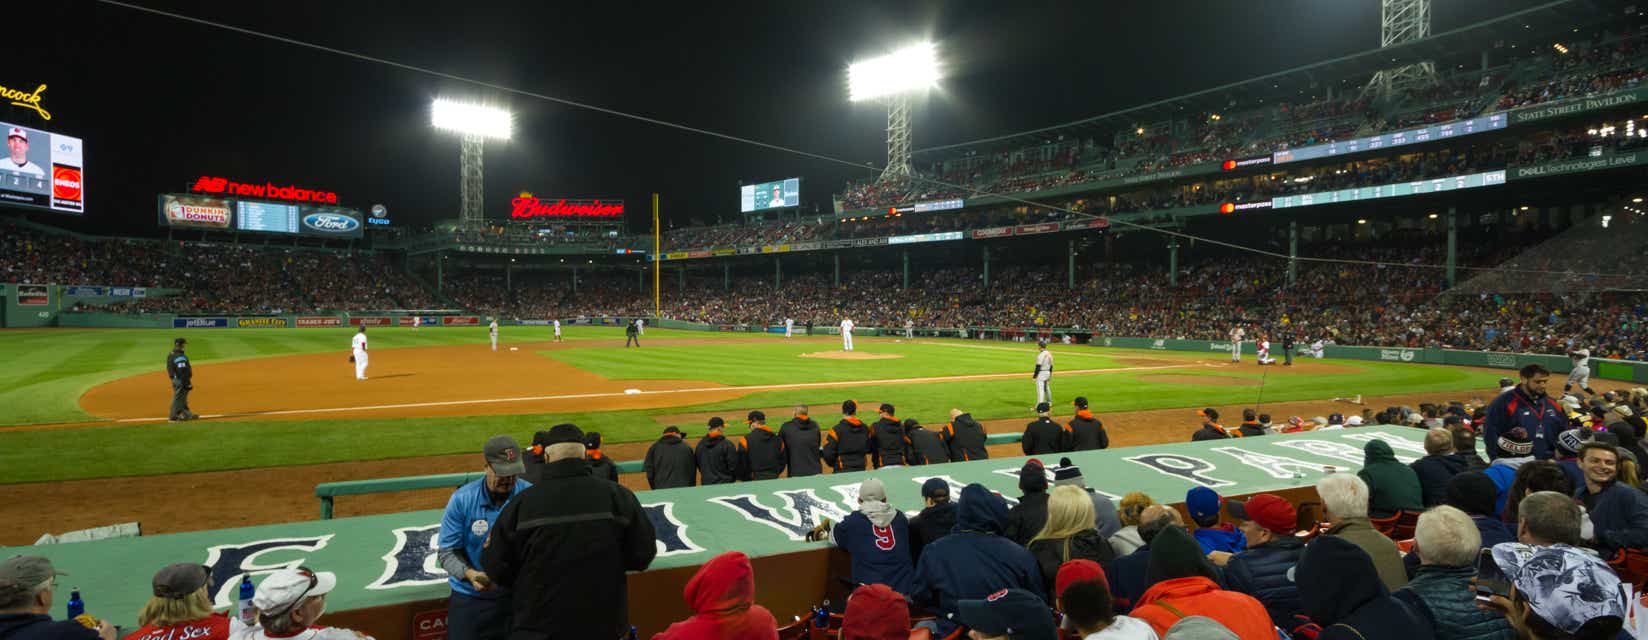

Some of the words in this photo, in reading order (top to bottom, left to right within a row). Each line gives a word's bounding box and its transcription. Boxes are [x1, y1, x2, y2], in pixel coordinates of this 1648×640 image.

[0, 84, 51, 120] ncock
[1518, 111, 1547, 122] STATE
[1547, 103, 1582, 117] STREET
[1585, 93, 1637, 110] PAVILION
[1519, 165, 1547, 177] DELL
[1547, 157, 1608, 174] Technologies
[1609, 154, 1636, 166] Level
[228, 181, 266, 199] new
[266, 183, 337, 204] balance
[186, 213, 225, 222] DONUTS
[511, 197, 624, 218] Budweiser
[315, 215, 349, 230] Ford
[186, 319, 217, 328] jetBlue
[872, 520, 897, 551] 9
[179, 625, 211, 640] Sox
[419, 616, 448, 631] CA
